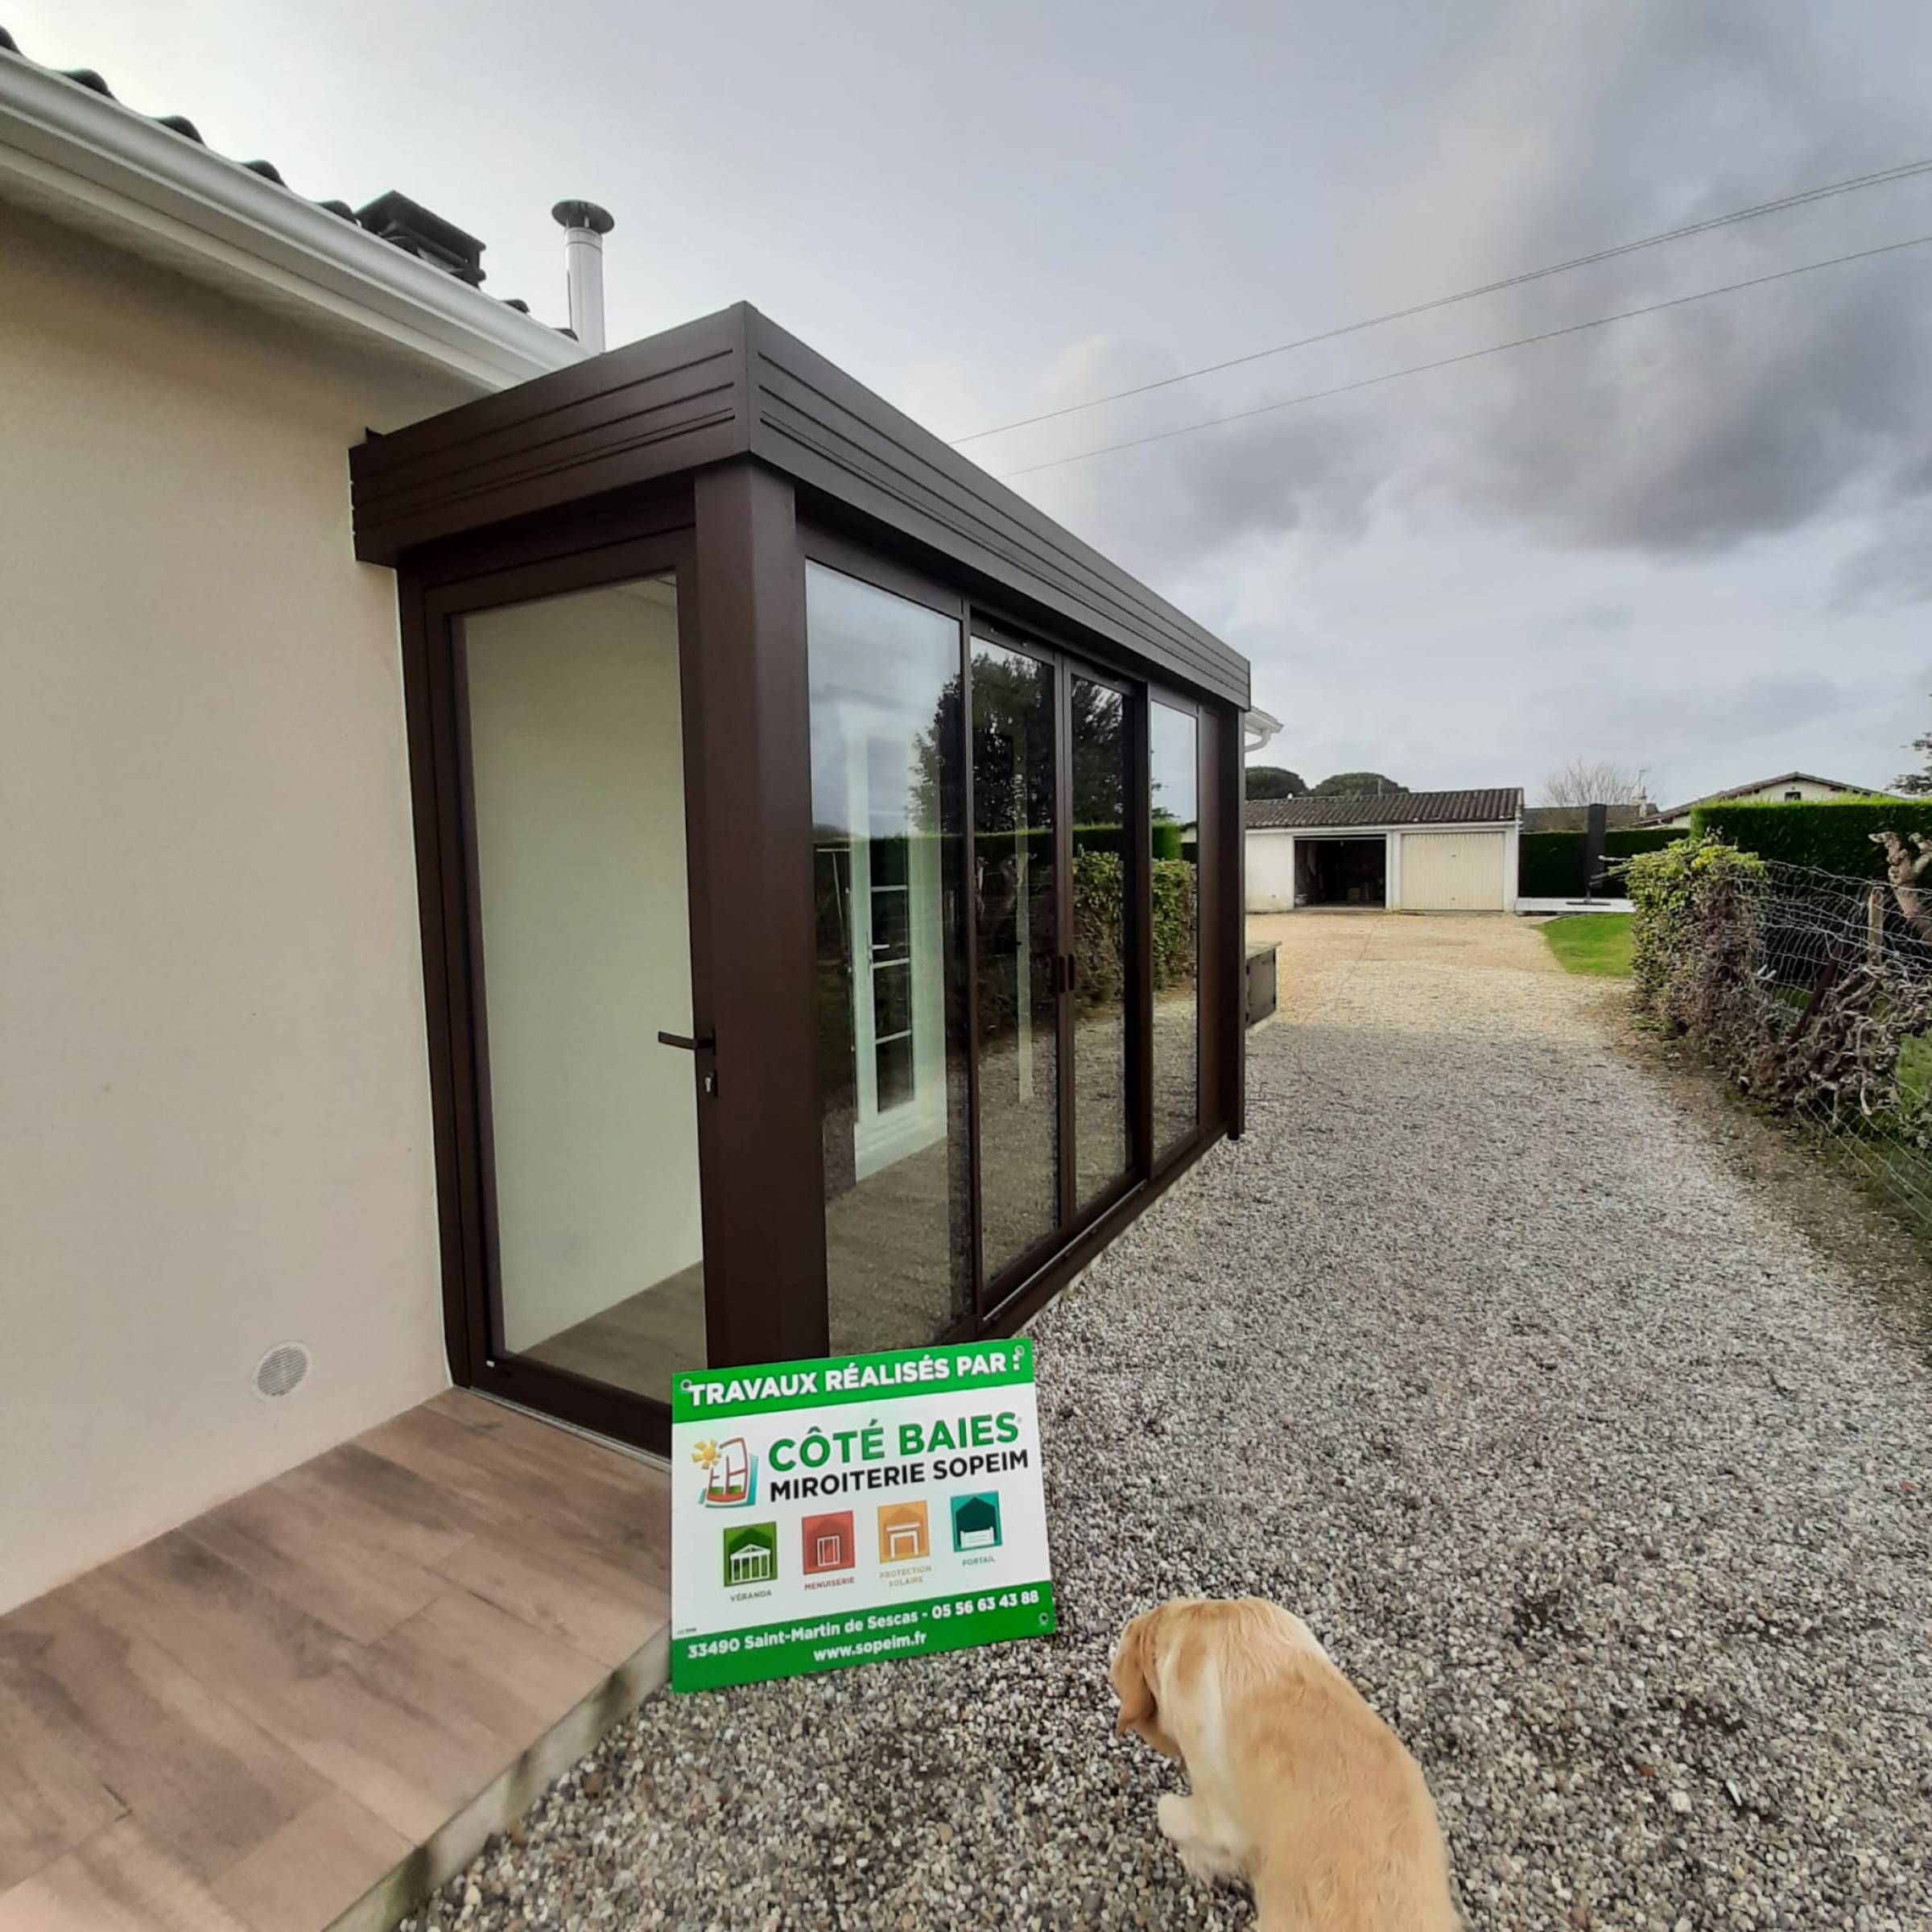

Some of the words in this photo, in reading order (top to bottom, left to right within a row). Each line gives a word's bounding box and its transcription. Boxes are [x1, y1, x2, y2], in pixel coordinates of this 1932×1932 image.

[690, 1372, 818, 1406] TRAVAUX
[826, 1355, 950, 1391] RÉALISÉS
[956, 1352, 1007, 1377] PAR
[768, 1418, 885, 1472] CÔTÉ
[898, 1411, 1019, 1455] BAIES
[770, 1463, 925, 1502] MIROITERIE
[933, 1449, 1029, 1480] SOPEIM
[879, 1565, 932, 1579] PROTECTION
[962, 1555, 996, 1567] PORTAIL
[804, 1576, 855, 1591] MENUISERIE
[889, 1575, 923, 1587] SOLAIRE
[687, 1638, 741, 1659] 33490
[745, 1622, 840, 1649] Saint-Martin
[844, 1619, 864, 1633] de
[867, 1612, 919, 1629] Sescas
[931, 1604, 952, 1619] 05
[955, 1600, 973, 1616] 56
[976, 1597, 995, 1612] 63
[999, 1593, 1018, 1608] 43
[1021, 1590, 1039, 1604] 88
[813, 1631, 927, 1661] www.sopeim.fr
